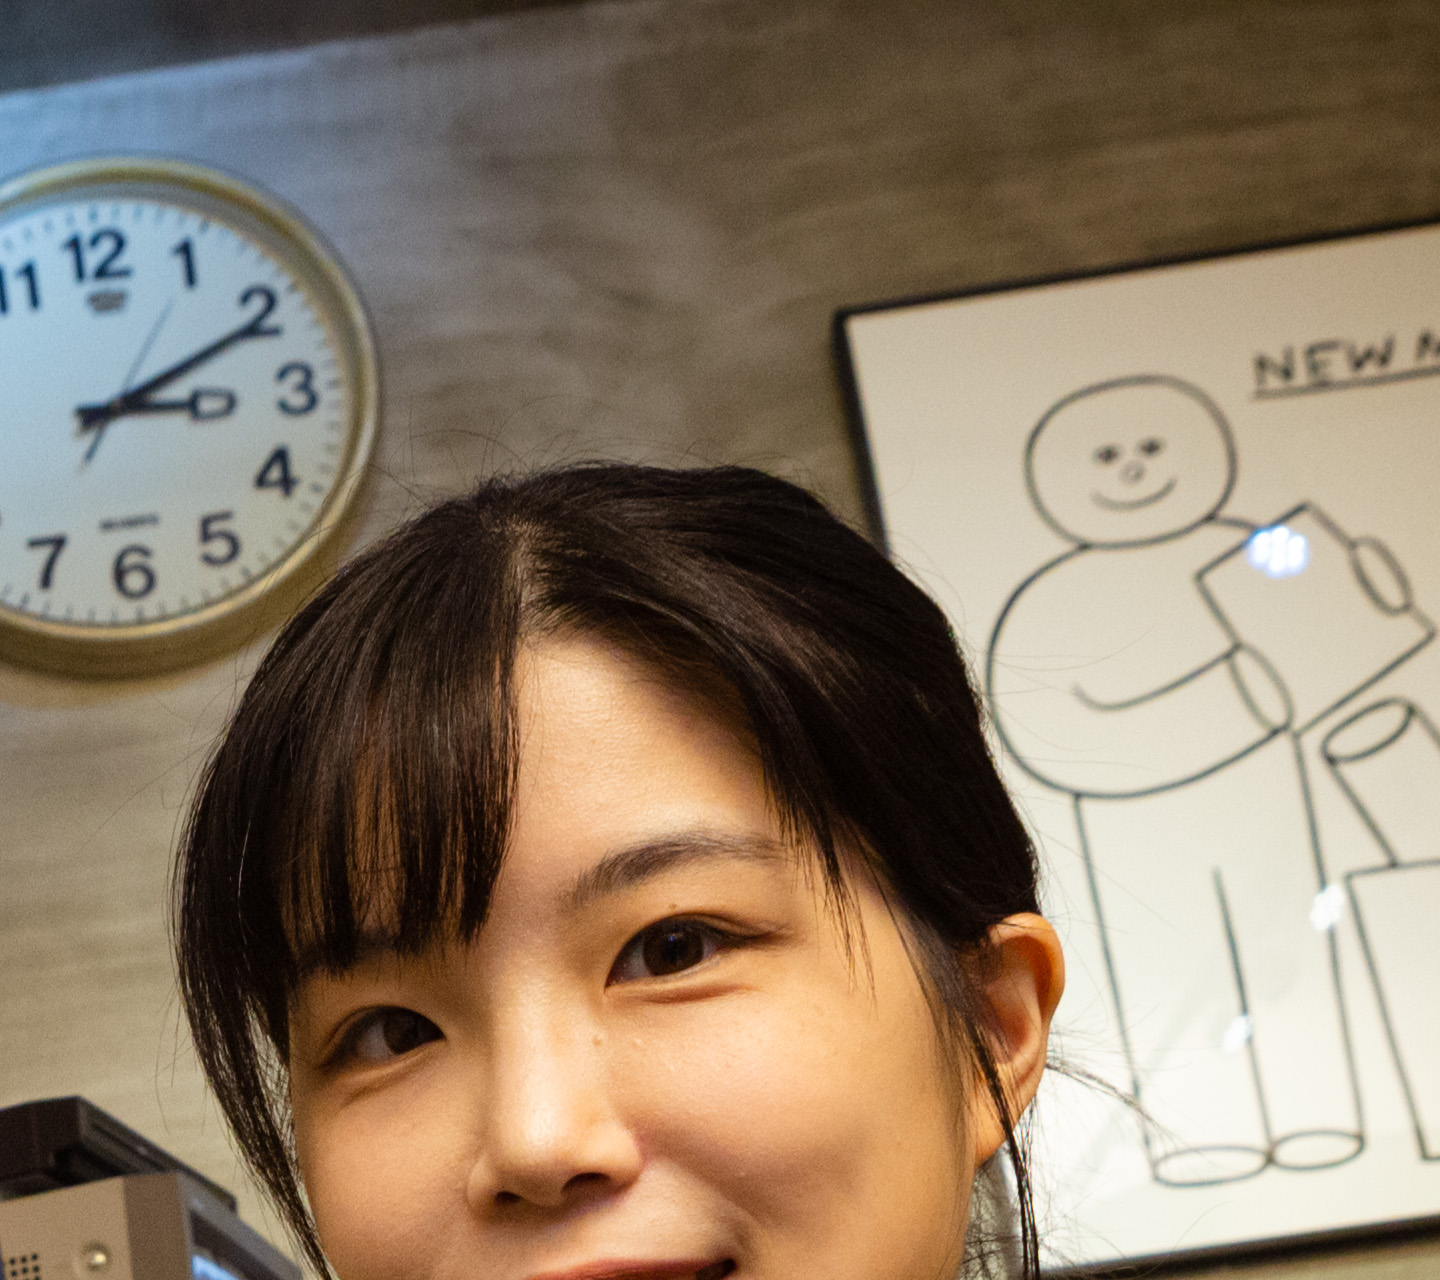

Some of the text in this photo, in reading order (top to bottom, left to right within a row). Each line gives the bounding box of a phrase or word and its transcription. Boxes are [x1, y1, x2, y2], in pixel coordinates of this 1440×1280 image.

[65, 229, 130, 281] 12
[173, 236, 198, 289] 1
[239, 286, 281, 337] 2
[1255, 334, 1397, 389] NEW
[275, 363, 318, 416] 3
[255, 448, 299, 498] 4
[28, 537, 67, 589] 7
[200, 512, 242, 567] 5
[113, 546, 158, 599] 6
